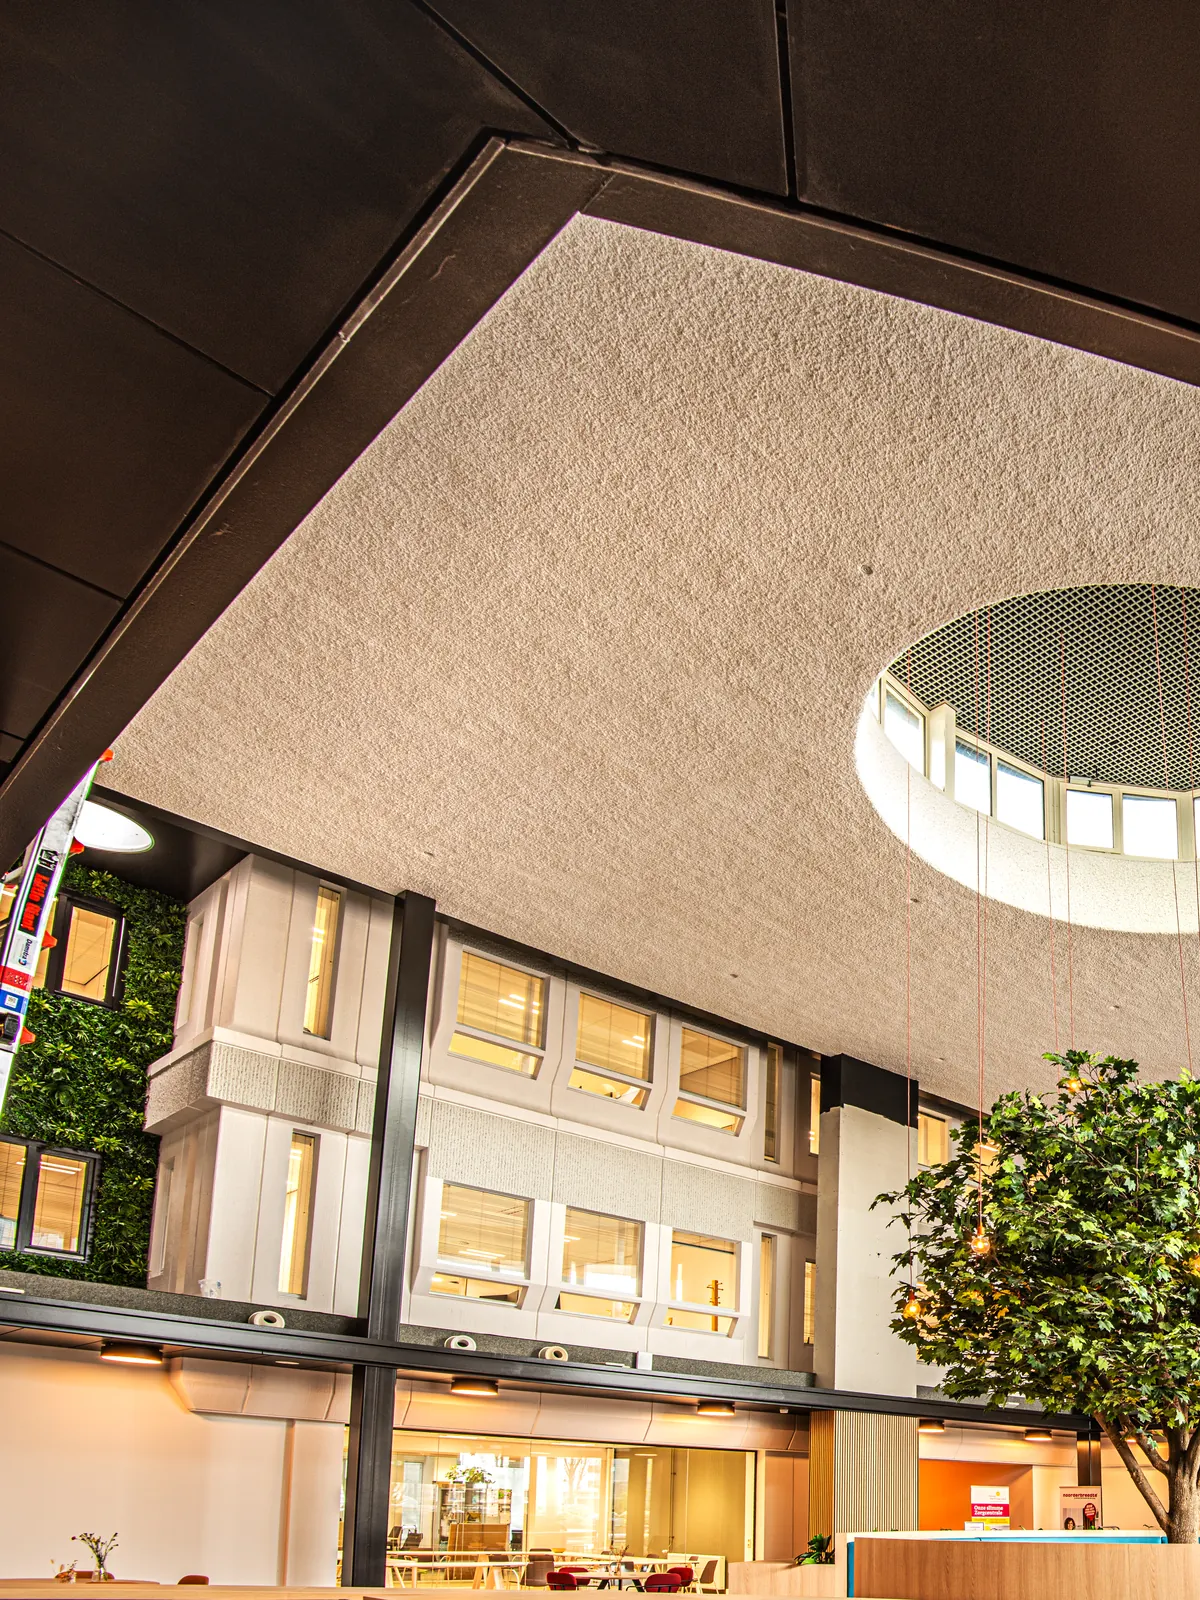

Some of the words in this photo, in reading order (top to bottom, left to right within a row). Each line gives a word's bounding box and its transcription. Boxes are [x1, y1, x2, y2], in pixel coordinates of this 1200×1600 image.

[29, 872, 50, 902] Little
[21, 902, 41, 931] Giant
[22, 938, 33, 959] Damstra
